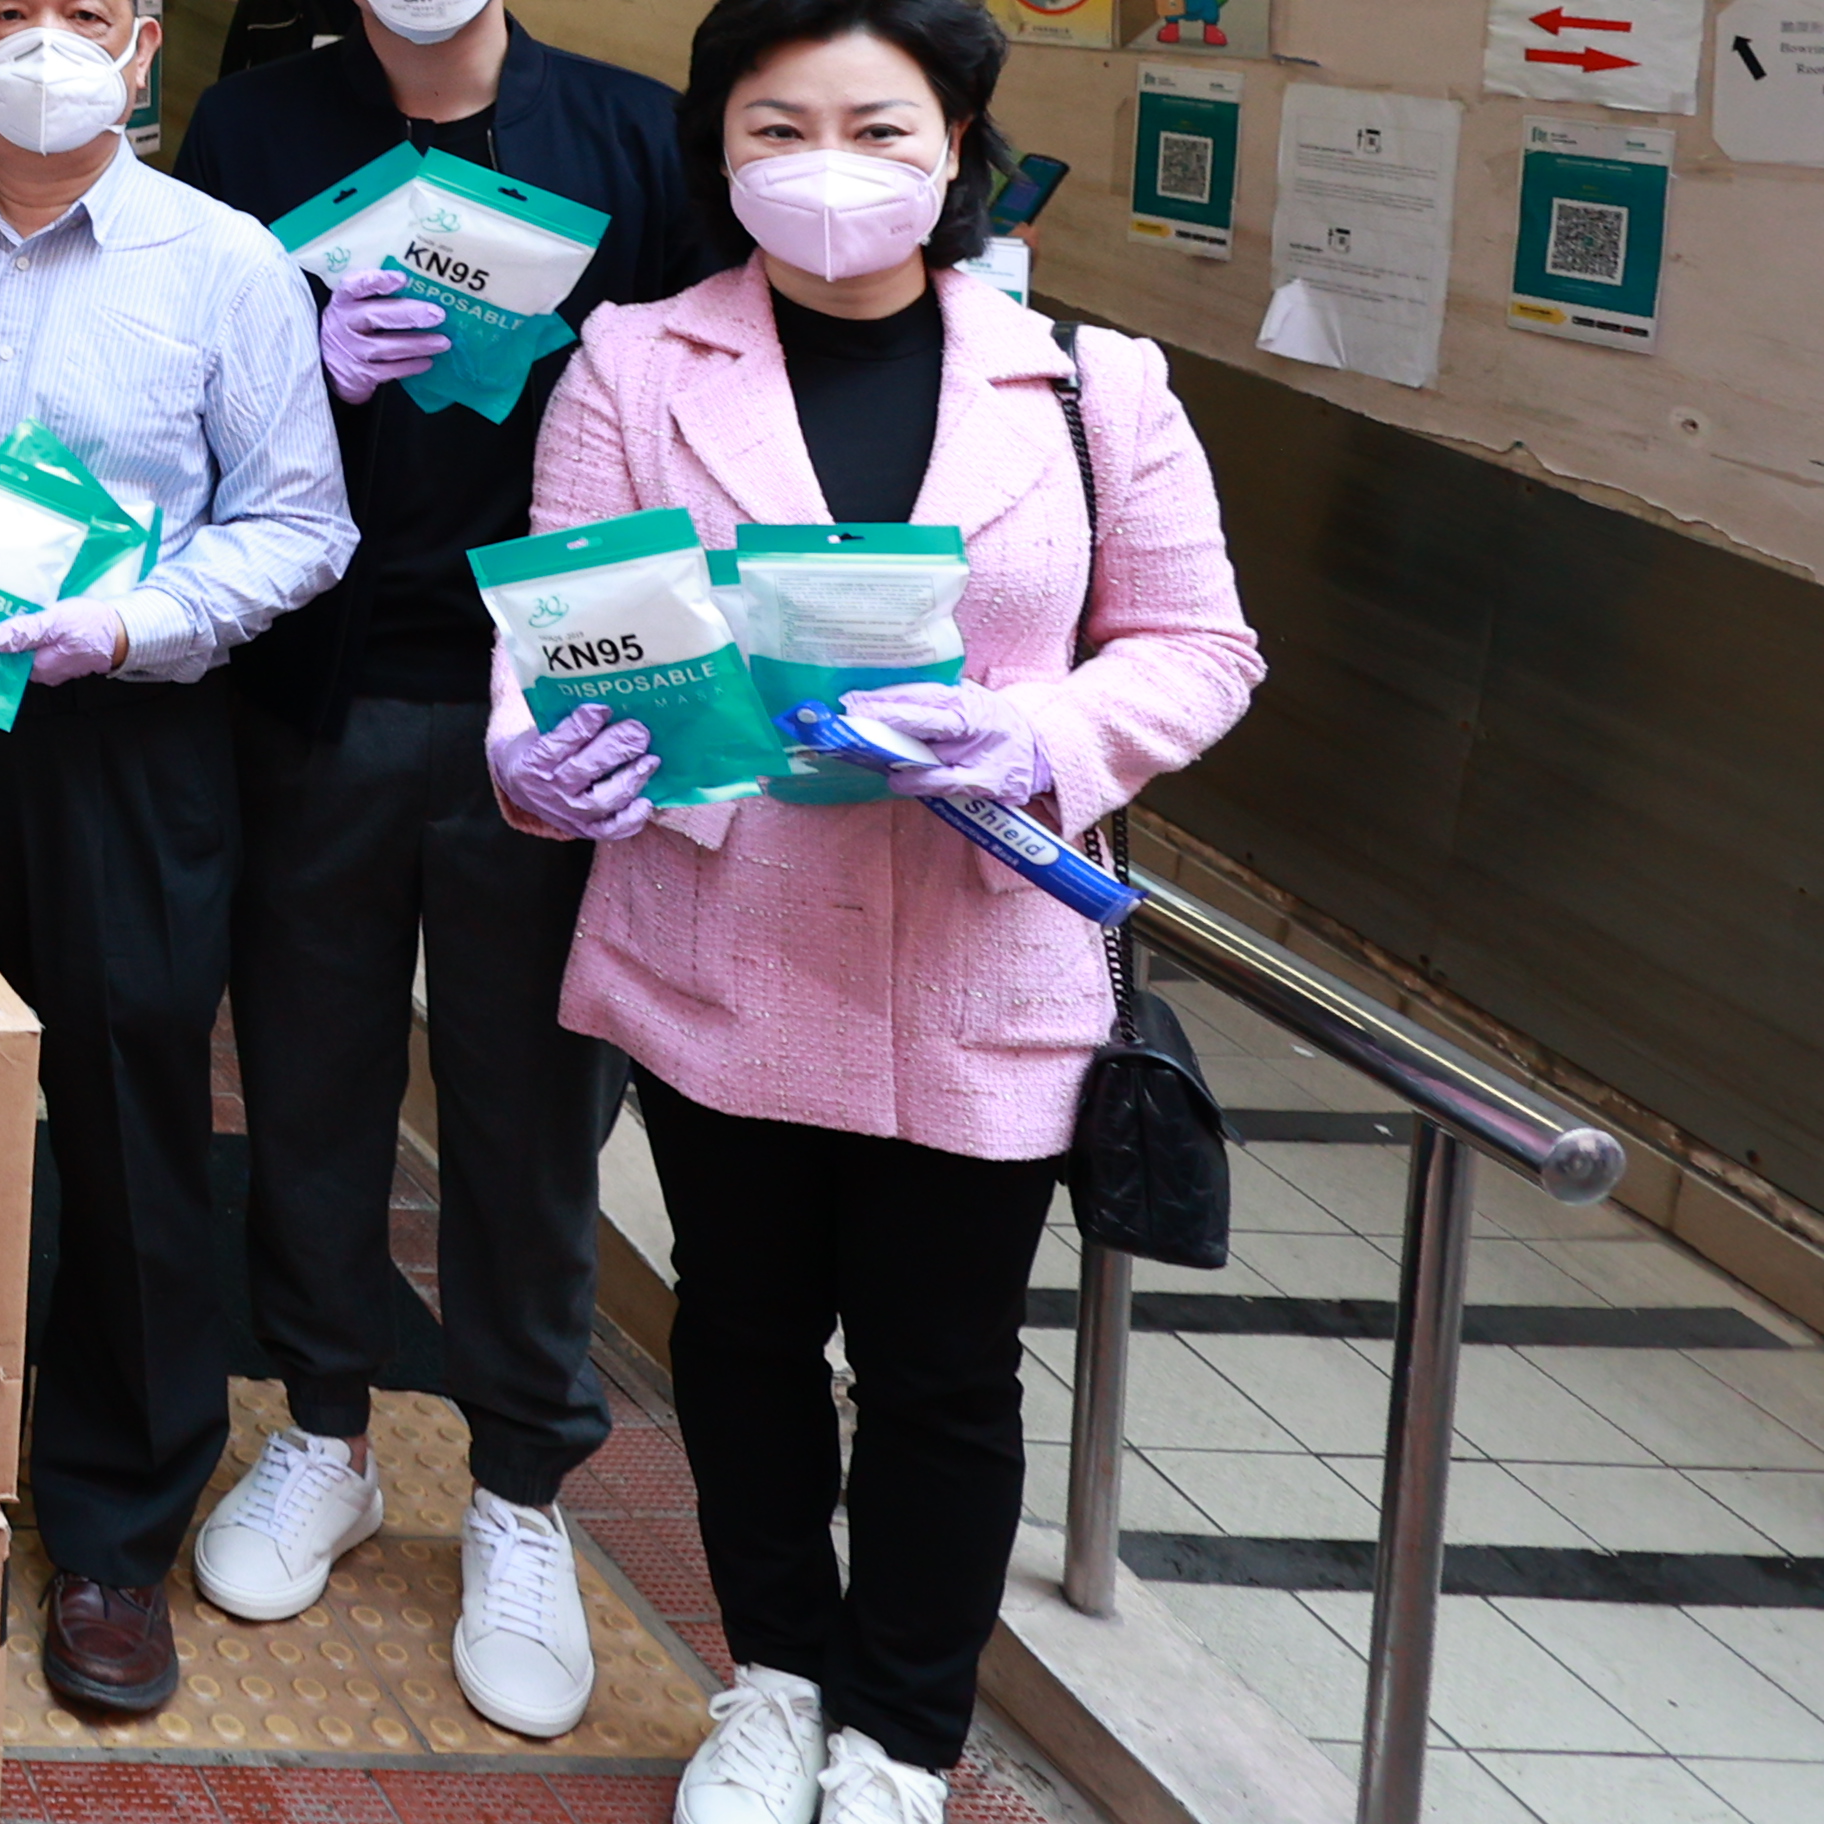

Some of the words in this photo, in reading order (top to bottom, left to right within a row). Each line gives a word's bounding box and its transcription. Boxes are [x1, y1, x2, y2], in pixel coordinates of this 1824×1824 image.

[403, 239, 491, 293] KN95
[541, 632, 645, 678] KN95
[556, 659, 719, 701] DISPOSABLE
[964, 798, 1046, 857] Shield
